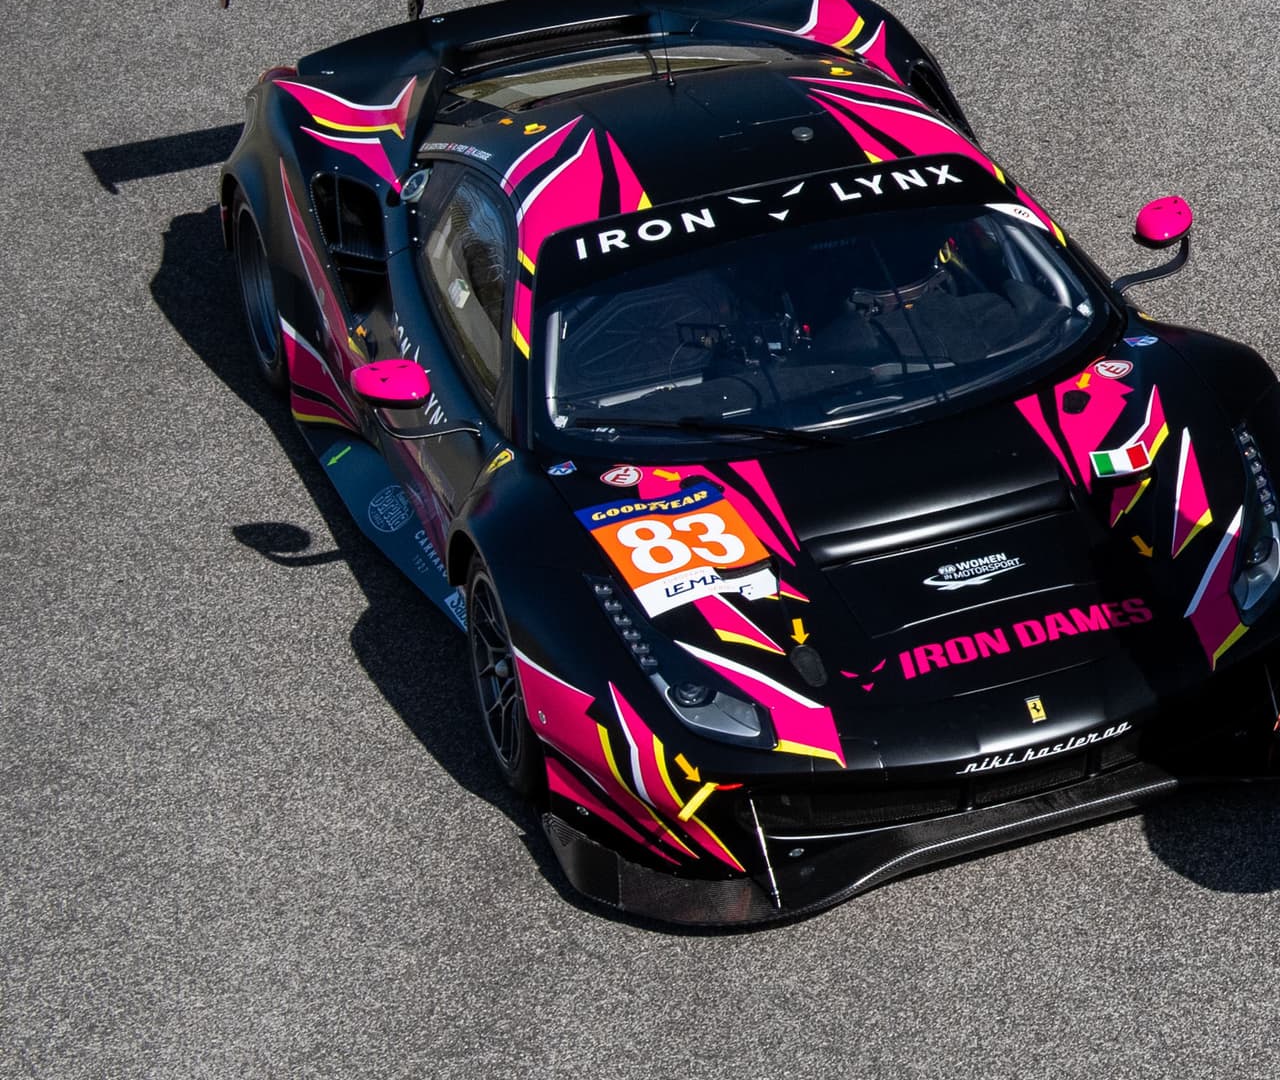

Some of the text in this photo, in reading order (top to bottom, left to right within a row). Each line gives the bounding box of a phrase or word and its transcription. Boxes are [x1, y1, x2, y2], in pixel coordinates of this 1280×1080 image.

[575, 163, 964, 261] IRON LYNX
[591, 490, 708, 521] GOODYEAR
[616, 512, 745, 574] 83
[952, 557, 1021, 580] MOTORSPORT
[955, 552, 1007, 571] WOMEN
[900, 598, 1153, 680] IRON DAMES
[956, 721, 1132, 775] niki hasler ag
